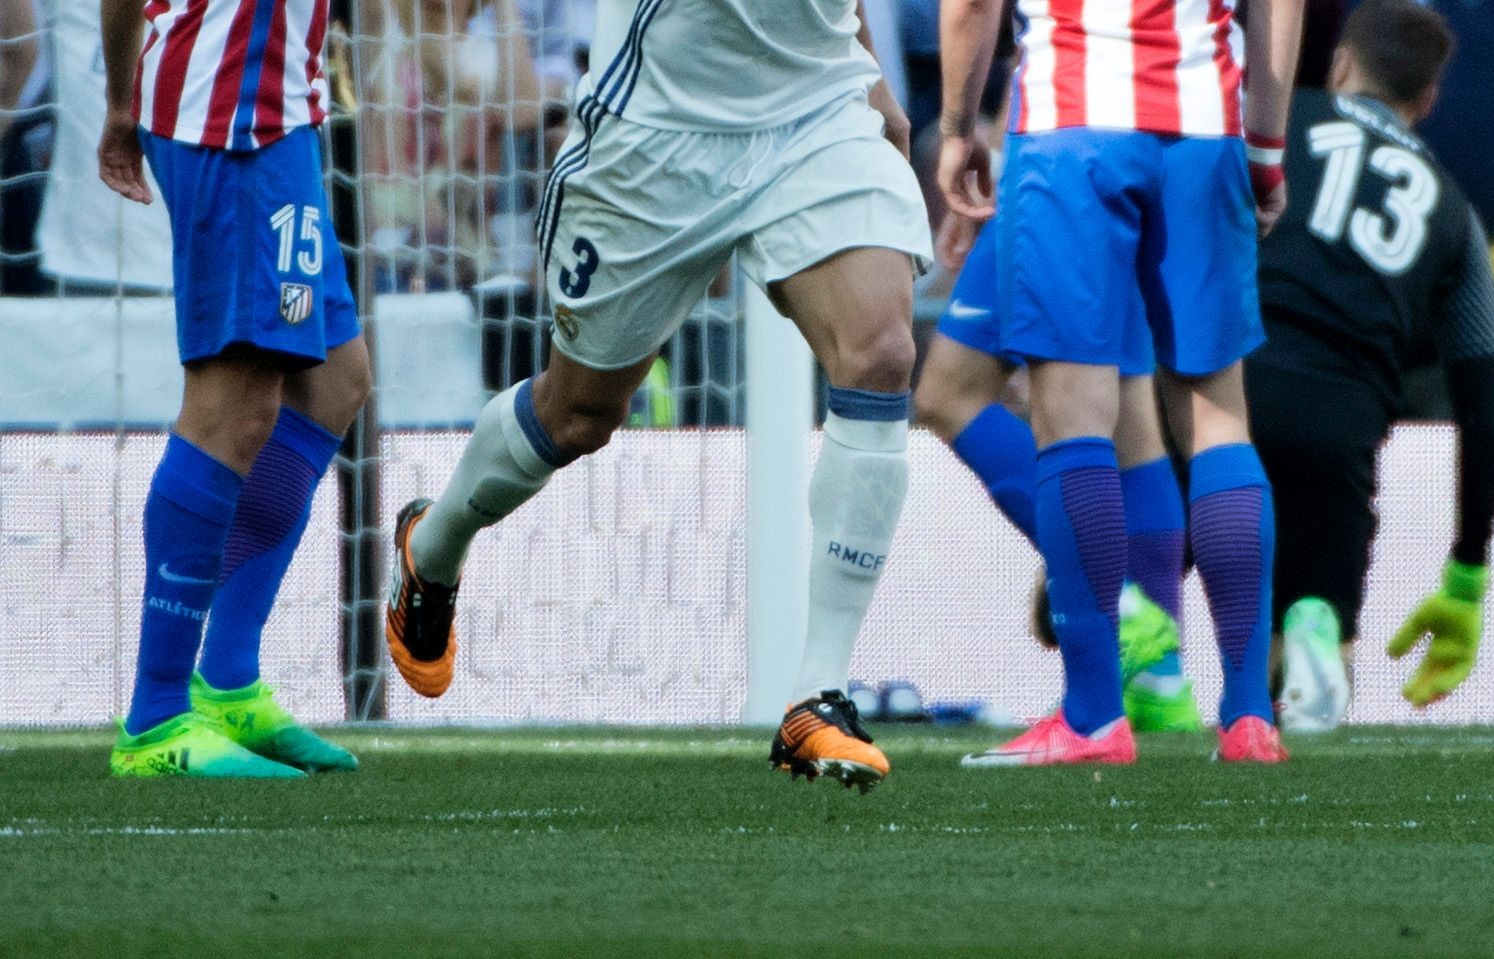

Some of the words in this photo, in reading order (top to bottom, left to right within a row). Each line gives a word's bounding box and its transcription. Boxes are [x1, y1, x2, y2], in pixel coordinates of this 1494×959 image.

[1309, 120, 1440, 274] 13
[270, 203, 323, 276] 15
[559, 236, 600, 299] 3
[828, 540, 886, 570] RMCF
